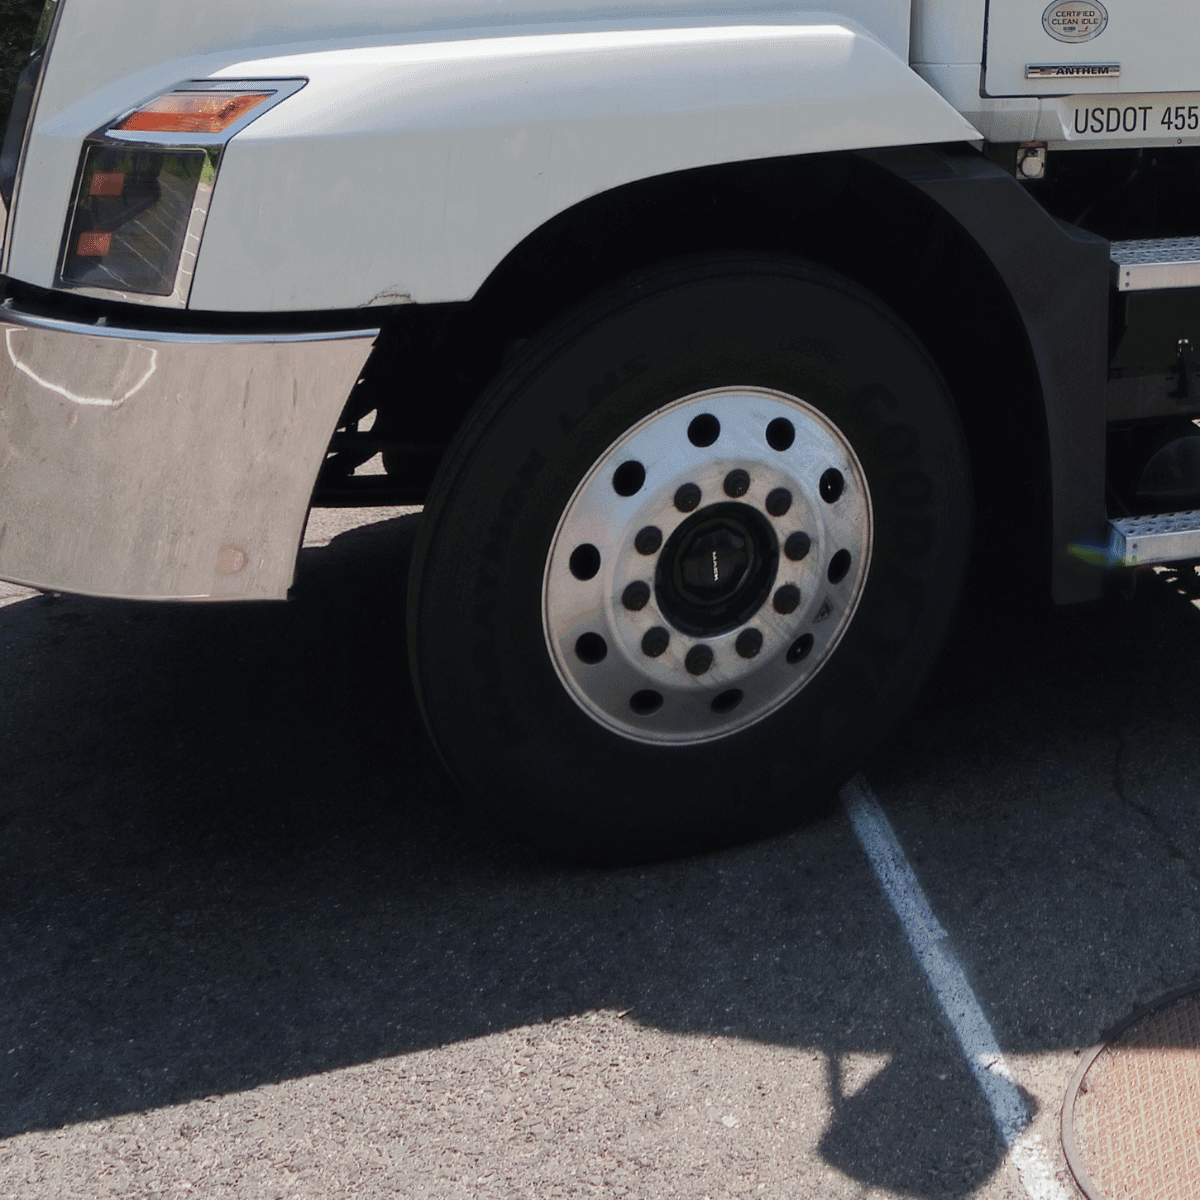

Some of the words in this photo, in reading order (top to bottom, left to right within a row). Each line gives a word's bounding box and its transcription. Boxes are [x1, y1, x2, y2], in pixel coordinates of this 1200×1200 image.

[1055, 10, 1096, 18] CERTIFIED
[1051, 18, 1079, 26] CLEAN
[1055, 66, 1109, 75] ANTHEM
[1074, 106, 1153, 134] USDOT
